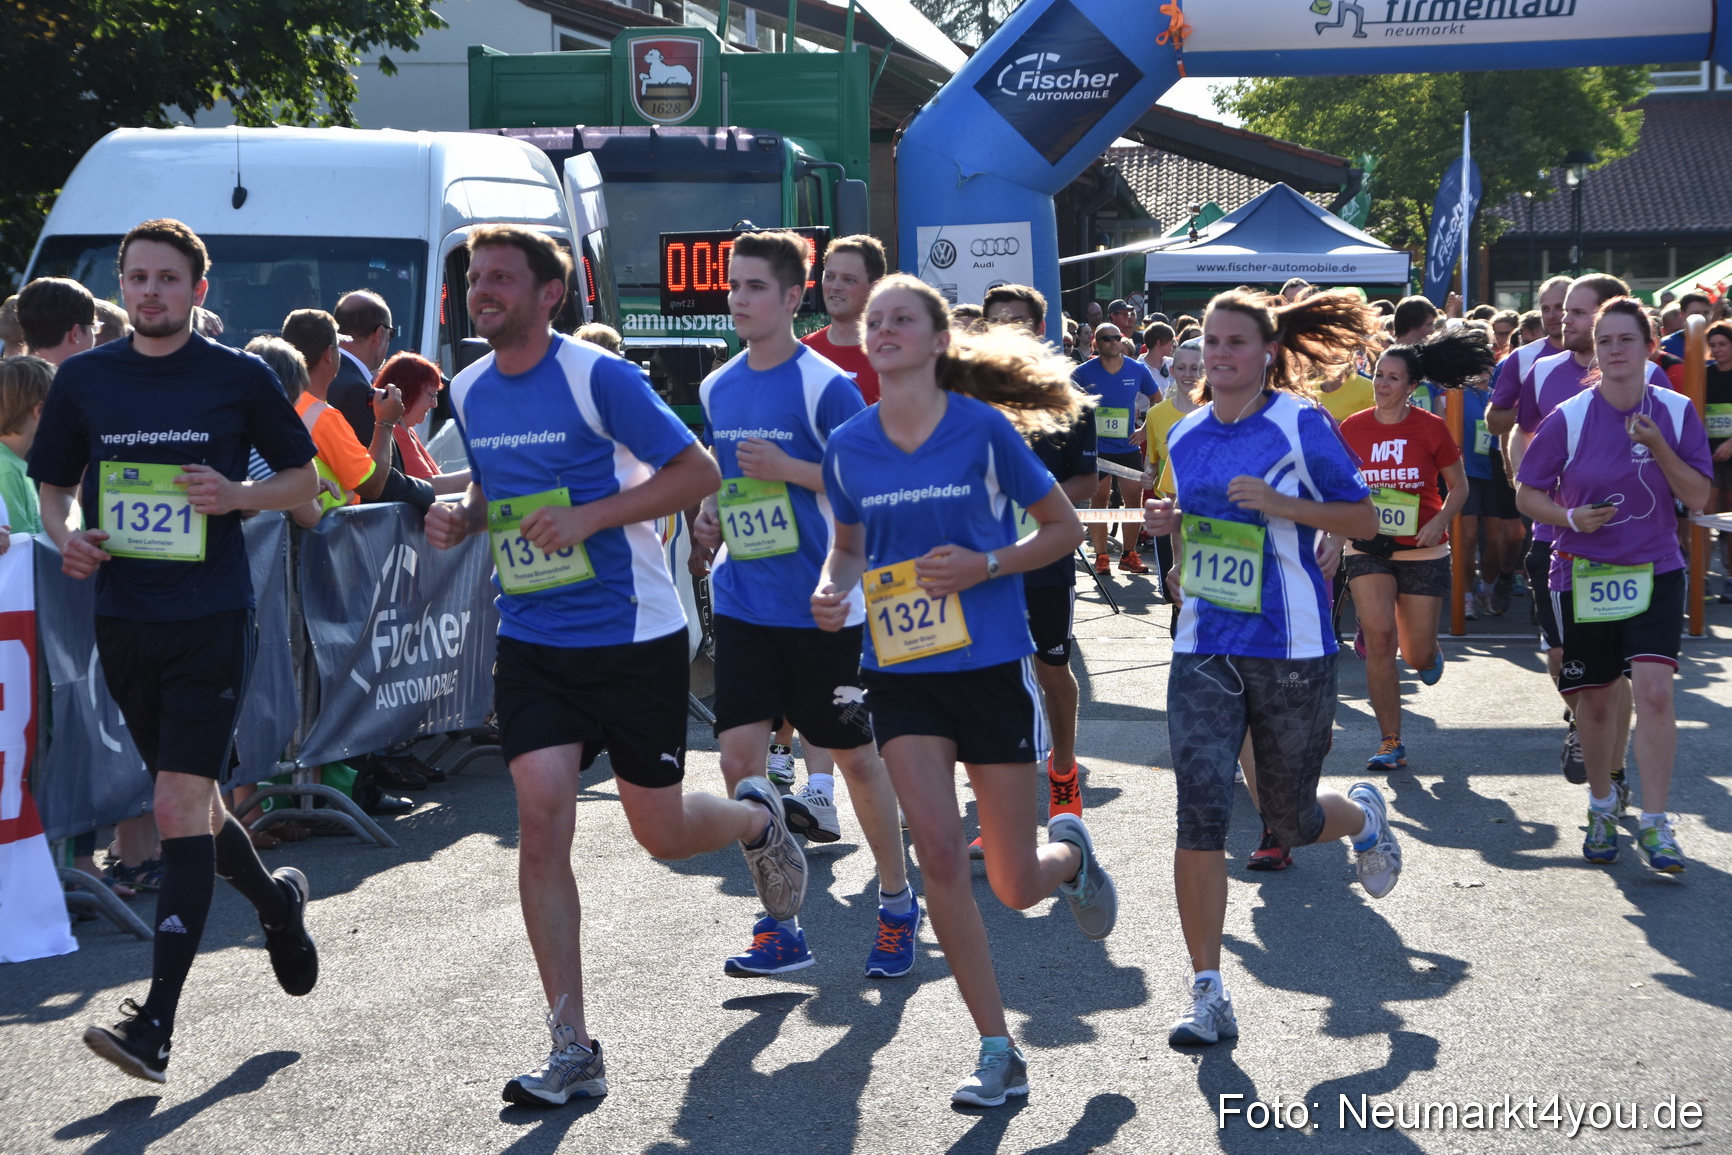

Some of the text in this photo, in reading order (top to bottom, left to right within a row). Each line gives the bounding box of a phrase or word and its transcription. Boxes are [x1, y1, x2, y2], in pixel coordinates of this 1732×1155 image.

[1385, 23, 1466, 37] neumarkt
[1018, 69, 1119, 90] Fischer
[1027, 90, 1110, 101] AUTOMOBILE
[651, 103, 682, 114] 1628
[972, 261, 995, 269] Audi
[1196, 262, 1357, 273] www.fischer-automobile.de
[669, 300, 695, 309] sport 23
[1105, 419, 1119, 430] 18
[470, 430, 566, 448] energiegeladen
[1398, 481, 1424, 489] Team
[861, 484, 971, 507] energiegeladen
[111, 500, 191, 534] 1321
[727, 505, 788, 537] 1314
[500, 536, 574, 568] 13
[1192, 550, 1254, 587] 1120
[513, 572, 534, 580] Thomas
[1590, 579, 1638, 602] 506
[878, 595, 948, 637] 1327
[1564, 667, 1583, 675] FCN
[158, 925, 187, 934] adidas
